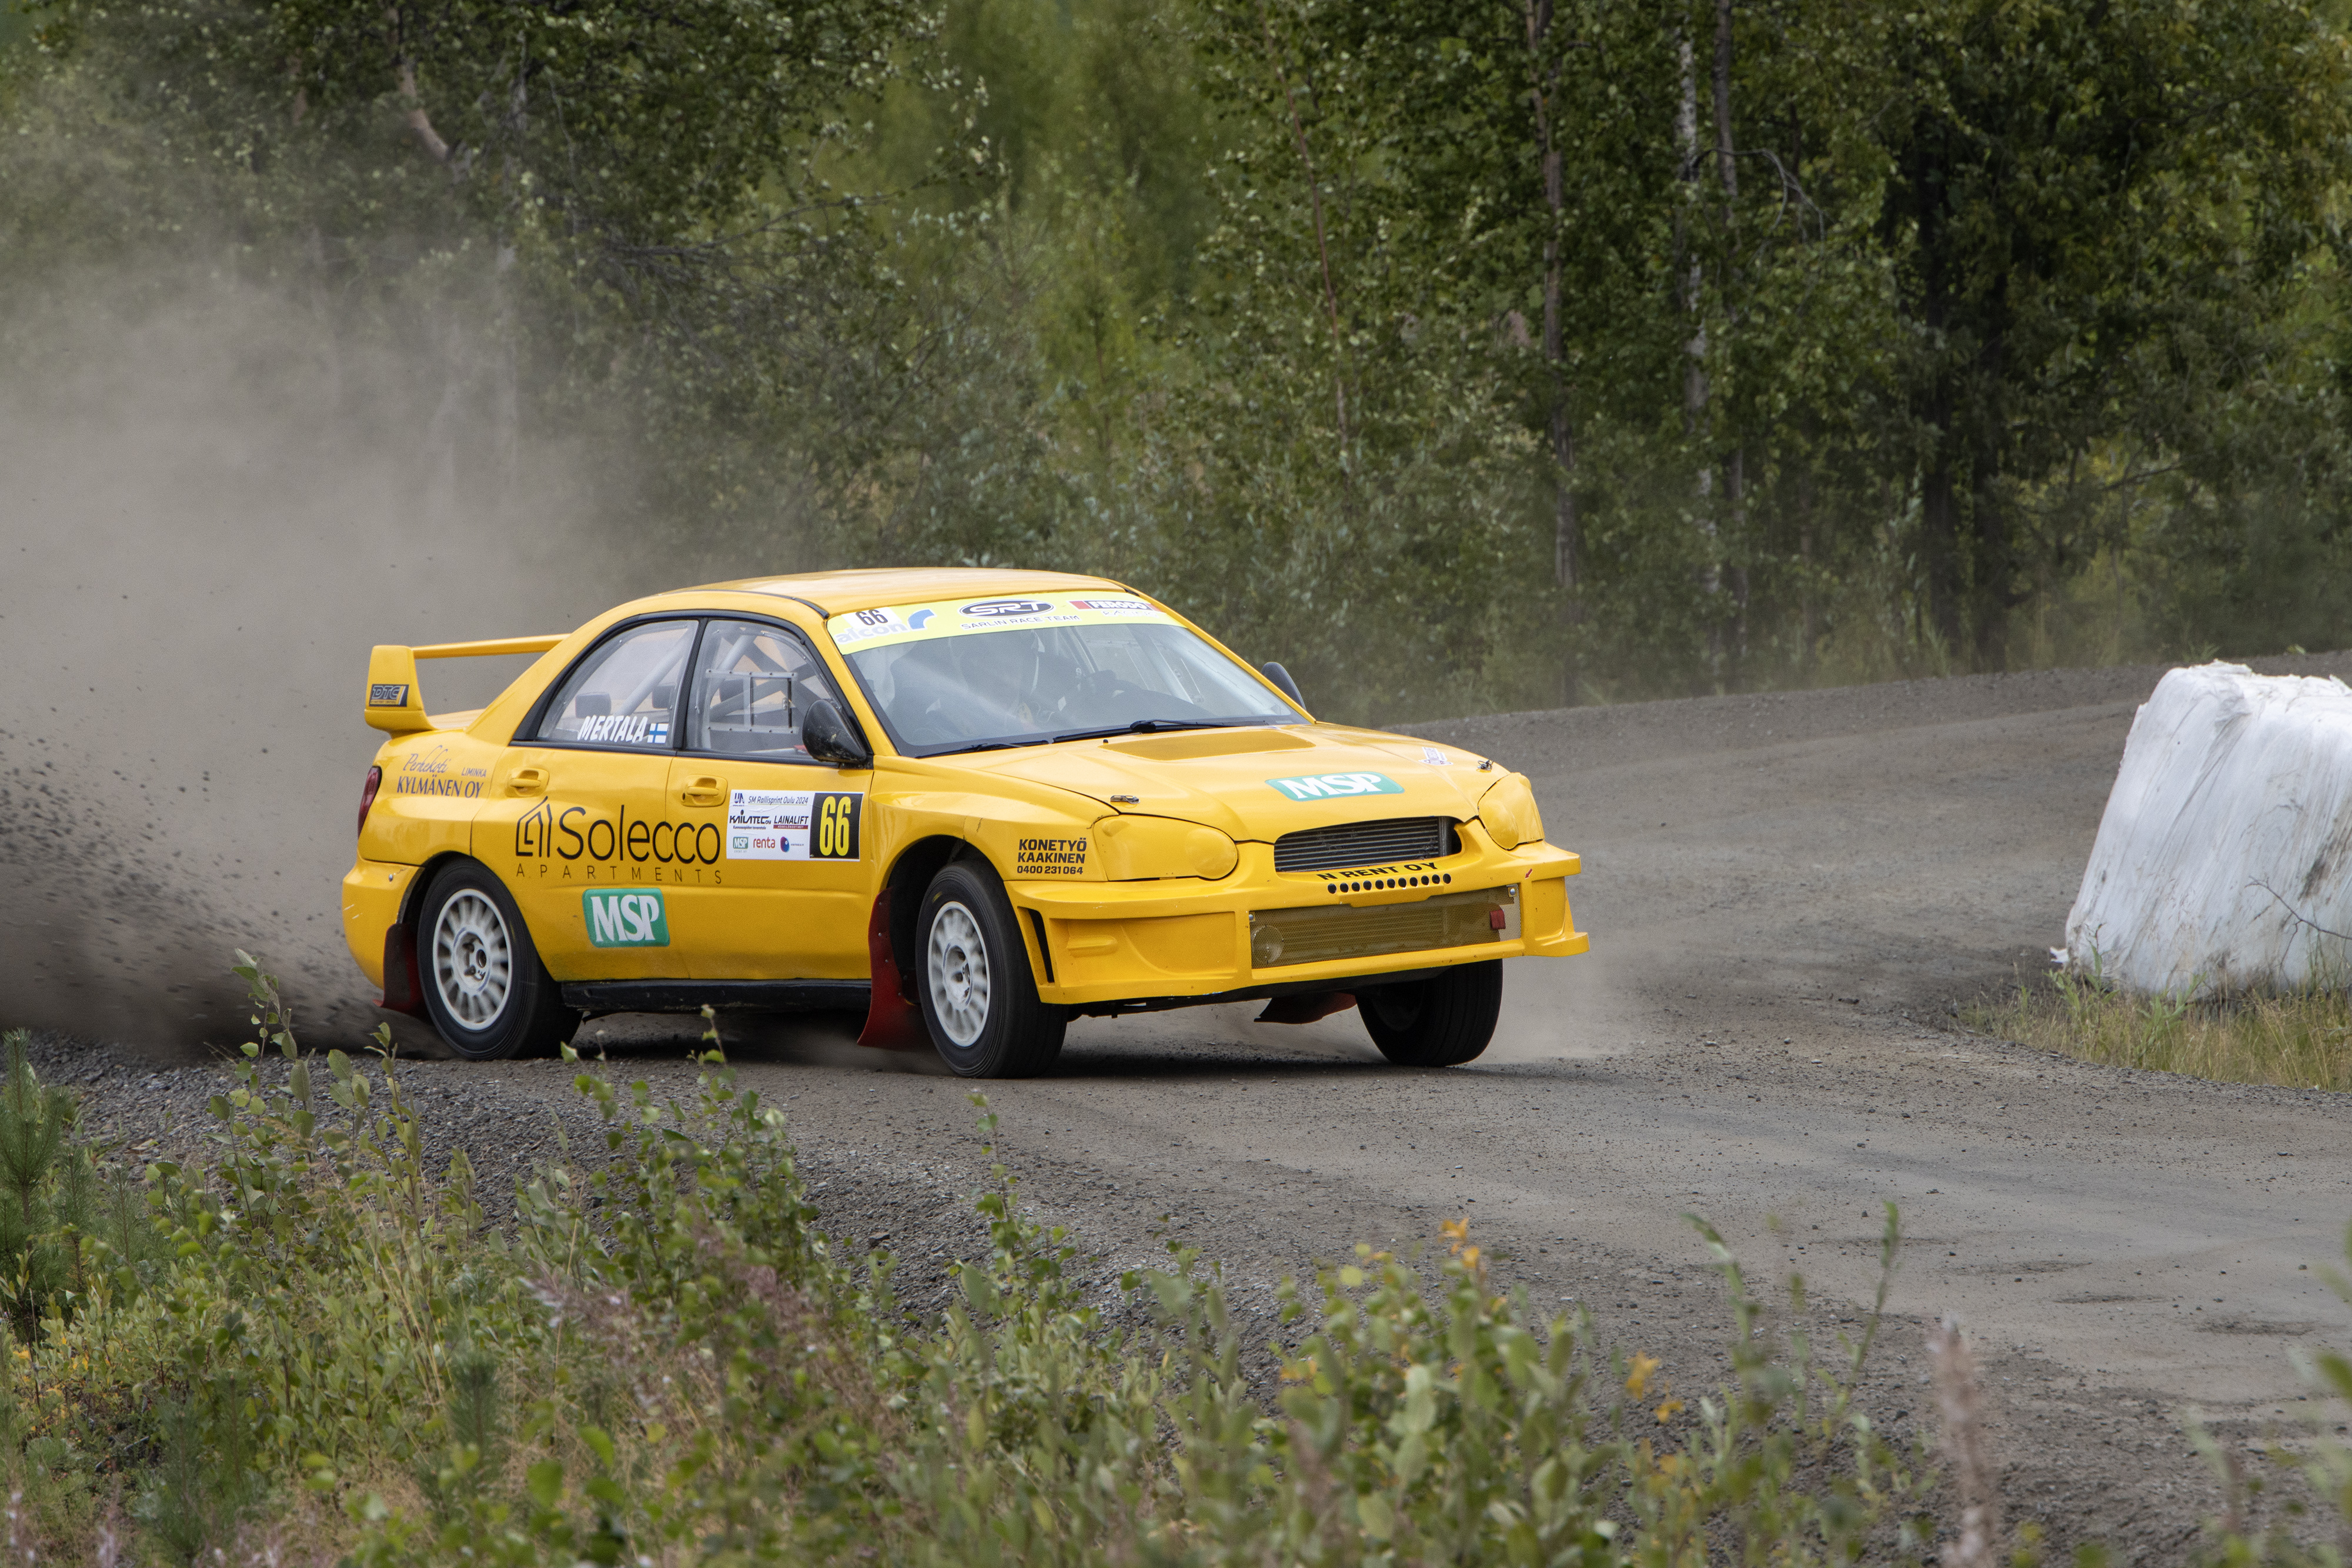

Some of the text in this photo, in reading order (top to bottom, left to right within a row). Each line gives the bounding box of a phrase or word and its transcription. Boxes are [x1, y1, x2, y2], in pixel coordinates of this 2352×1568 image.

[966, 601, 1049, 617] SRT
[1088, 601, 1148, 610] FERODO
[855, 609, 888, 626] 66
[961, 620, 1008, 630] SARLIN
[836, 623, 909, 643] alcon
[372, 686, 400, 699] DTC
[577, 714, 648, 744] MERTALA
[402, 744, 452, 773] Perhekoti
[461, 767, 487, 777] LIMINKA
[396, 774, 484, 798] KYLMÄNEN OY
[1278, 772, 1382, 800] MSP
[748, 795, 757, 804] SM
[757, 795, 783, 805] Rallisprint
[773, 815, 809, 824] LAINALIFT
[819, 795, 851, 856] 66
[556, 804, 721, 865] Solecco
[733, 837, 747, 848] MSP
[753, 836, 776, 849] renta
[1018, 837, 1087, 852] KONETYÖ
[1017, 852, 1085, 864] KAAKINEN
[516, 863, 722, 884] APARTMENTS
[1017, 865, 1043, 874] 0400
[1338, 866, 1399, 878] RENT
[1404, 862, 1438, 871] OY
[590, 894, 660, 942] MSP
